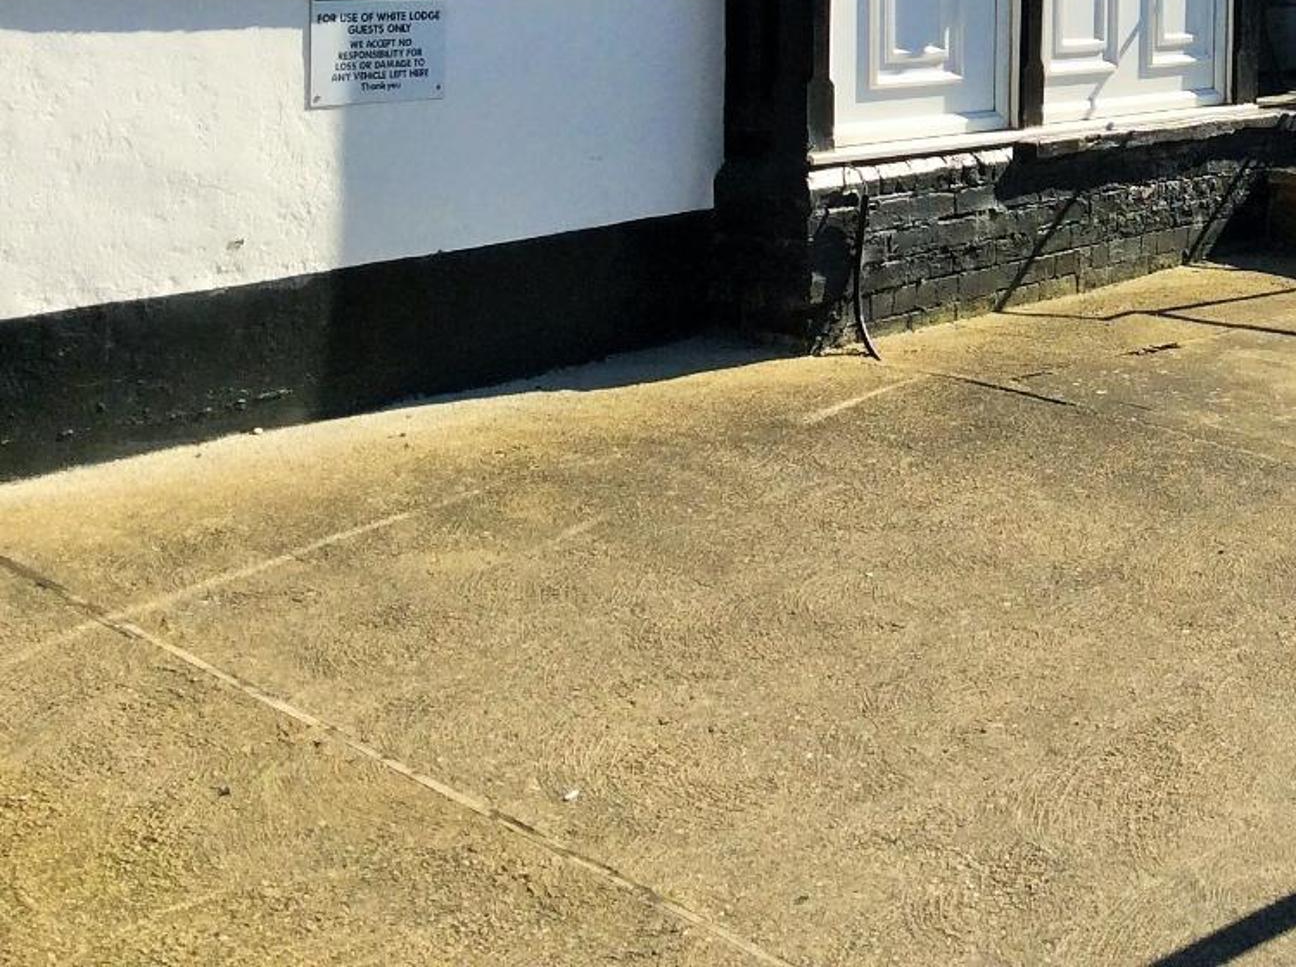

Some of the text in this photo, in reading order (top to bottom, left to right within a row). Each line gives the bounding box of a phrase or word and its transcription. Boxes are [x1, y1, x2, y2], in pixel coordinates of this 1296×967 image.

[317, 11, 440, 24] FOR USE OF WHITE LODGE
[347, 23, 412, 35] GUESTS ONLY
[350, 38, 412, 49] WE ACCEPT NO
[338, 48, 422, 60] RESPONSIBILITY FOR
[335, 58, 426, 71] LOSS OR DAMAGE TO
[331, 72, 351, 82] ANY
[354, 70, 387, 80] VEHICLE
[389, 69, 407, 79] LEFT
